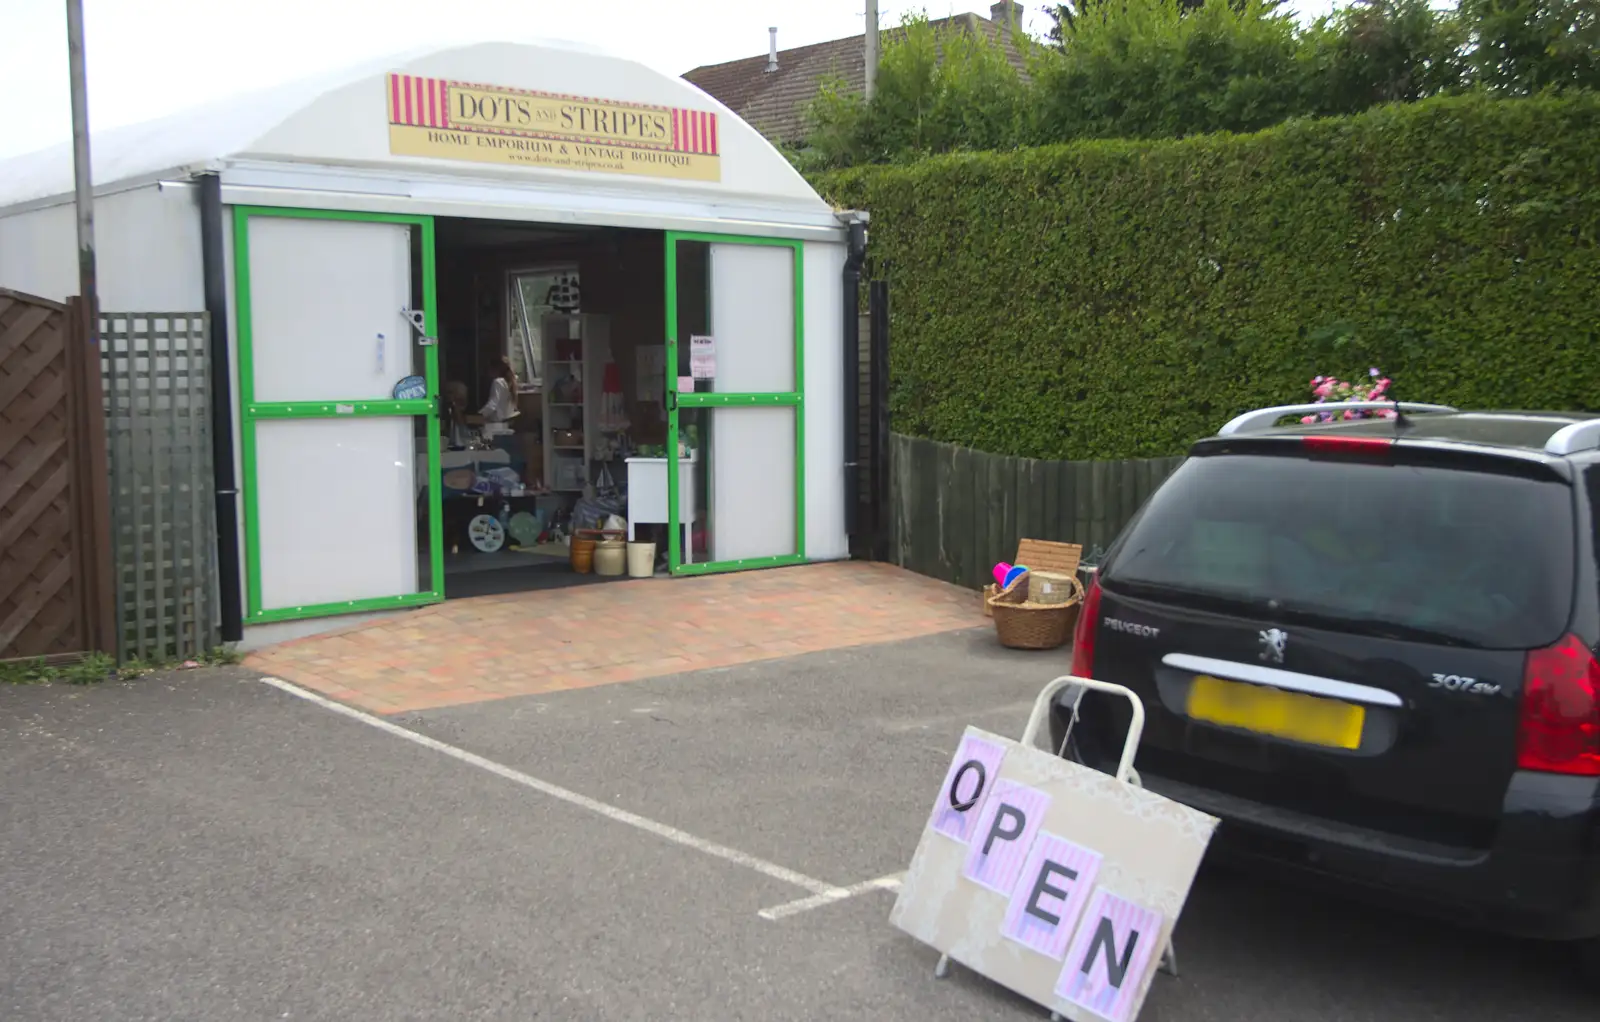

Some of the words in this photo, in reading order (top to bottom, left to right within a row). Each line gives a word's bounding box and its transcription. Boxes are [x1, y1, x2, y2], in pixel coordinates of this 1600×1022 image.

[457, 93, 532, 125] DOTS
[535, 108, 557, 122] AND
[560, 105, 667, 140] STRIPES
[428, 131, 470, 146] HOME
[476, 135, 553, 154] EMPORIUM
[559, 143, 569, 155] &
[575, 145, 625, 161] VINTAGE
[631, 151, 691, 168] BOUTIQUE
[1103, 616, 1161, 638] PEUGEOT
[949, 759, 1140, 990] OPEN
